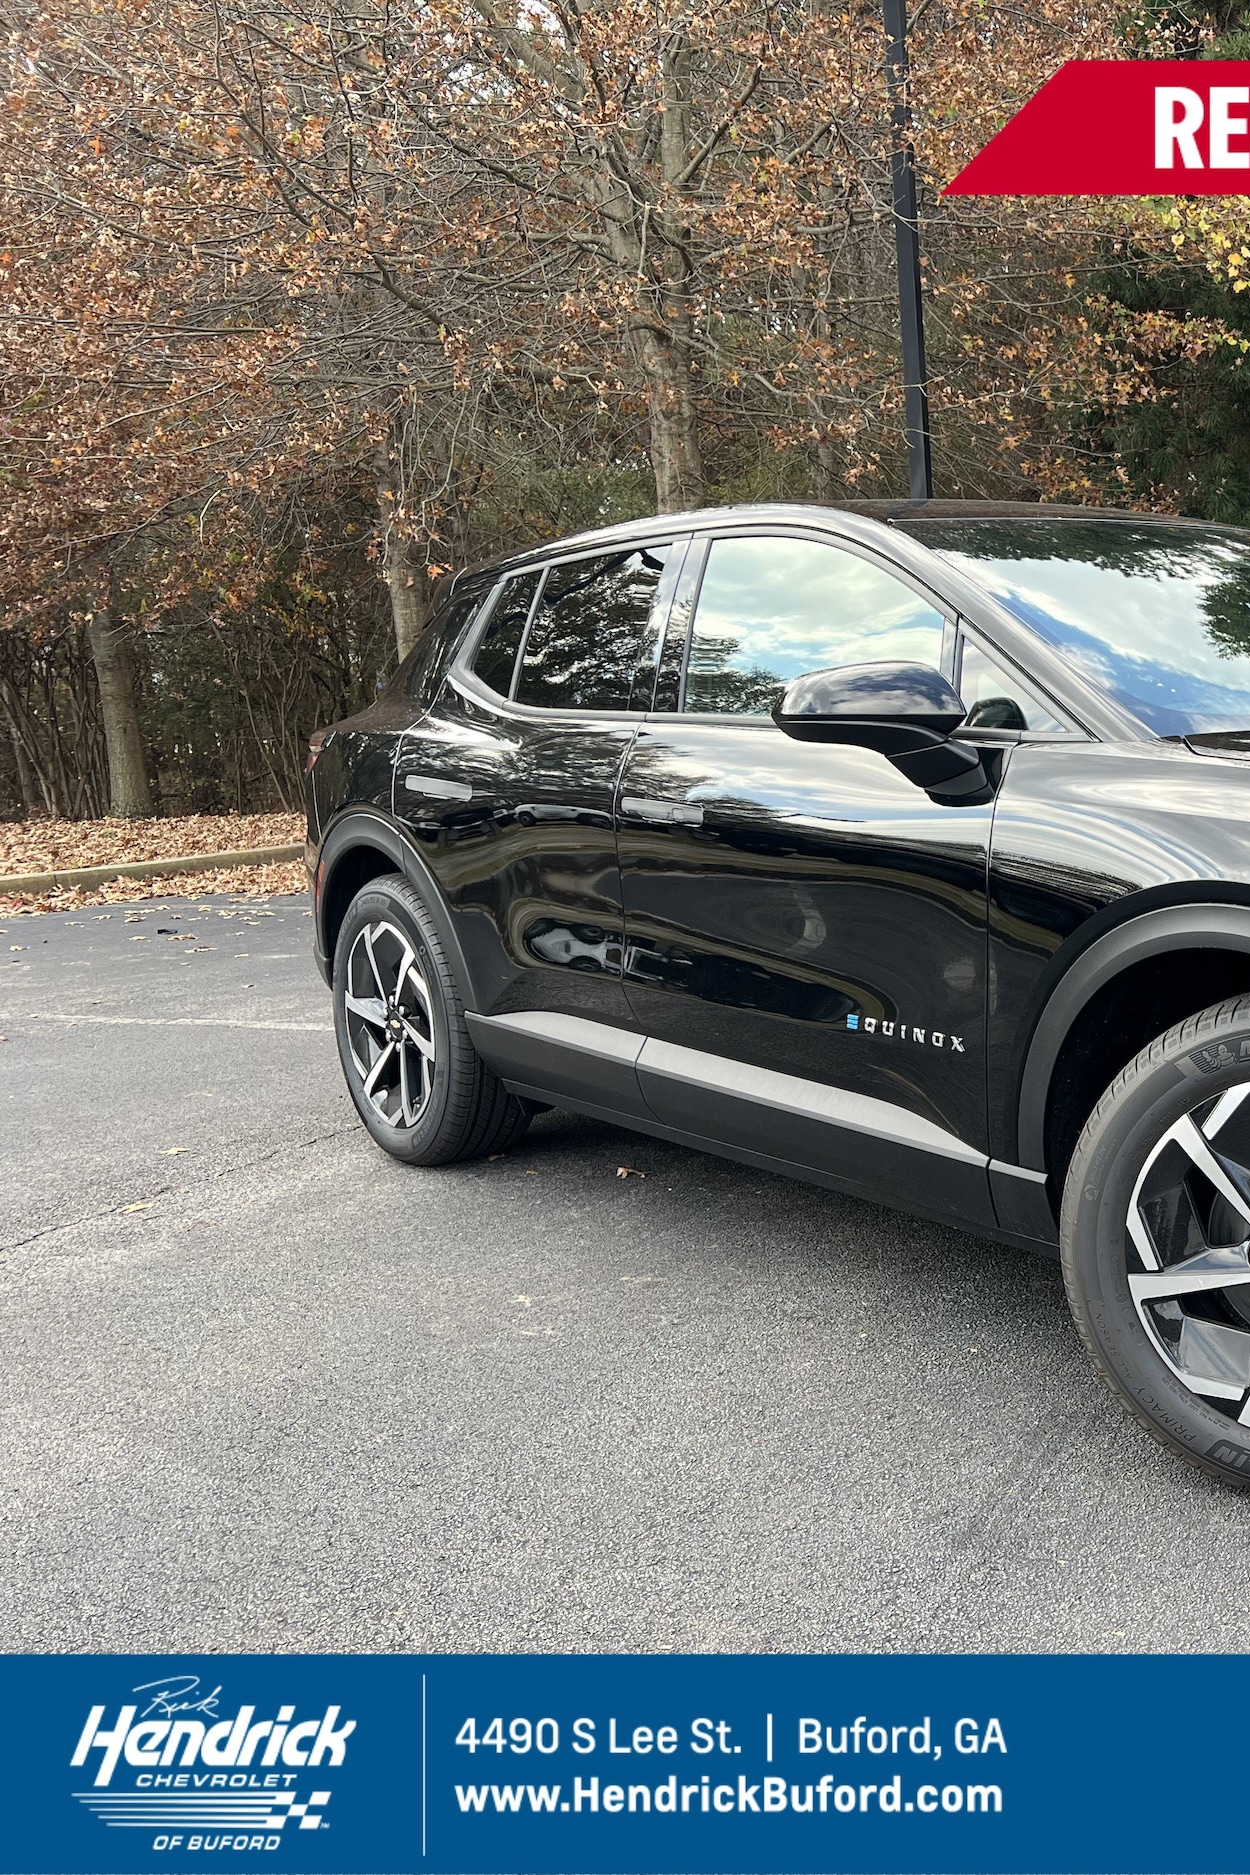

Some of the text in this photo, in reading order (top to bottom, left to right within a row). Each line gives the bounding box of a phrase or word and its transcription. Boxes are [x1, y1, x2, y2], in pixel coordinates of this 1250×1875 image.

[846, 1014, 966, 1053] EQUINOX
[1095, 1313, 1120, 1357] SEASON
[1132, 1386, 1197, 1442] PRIMACY
